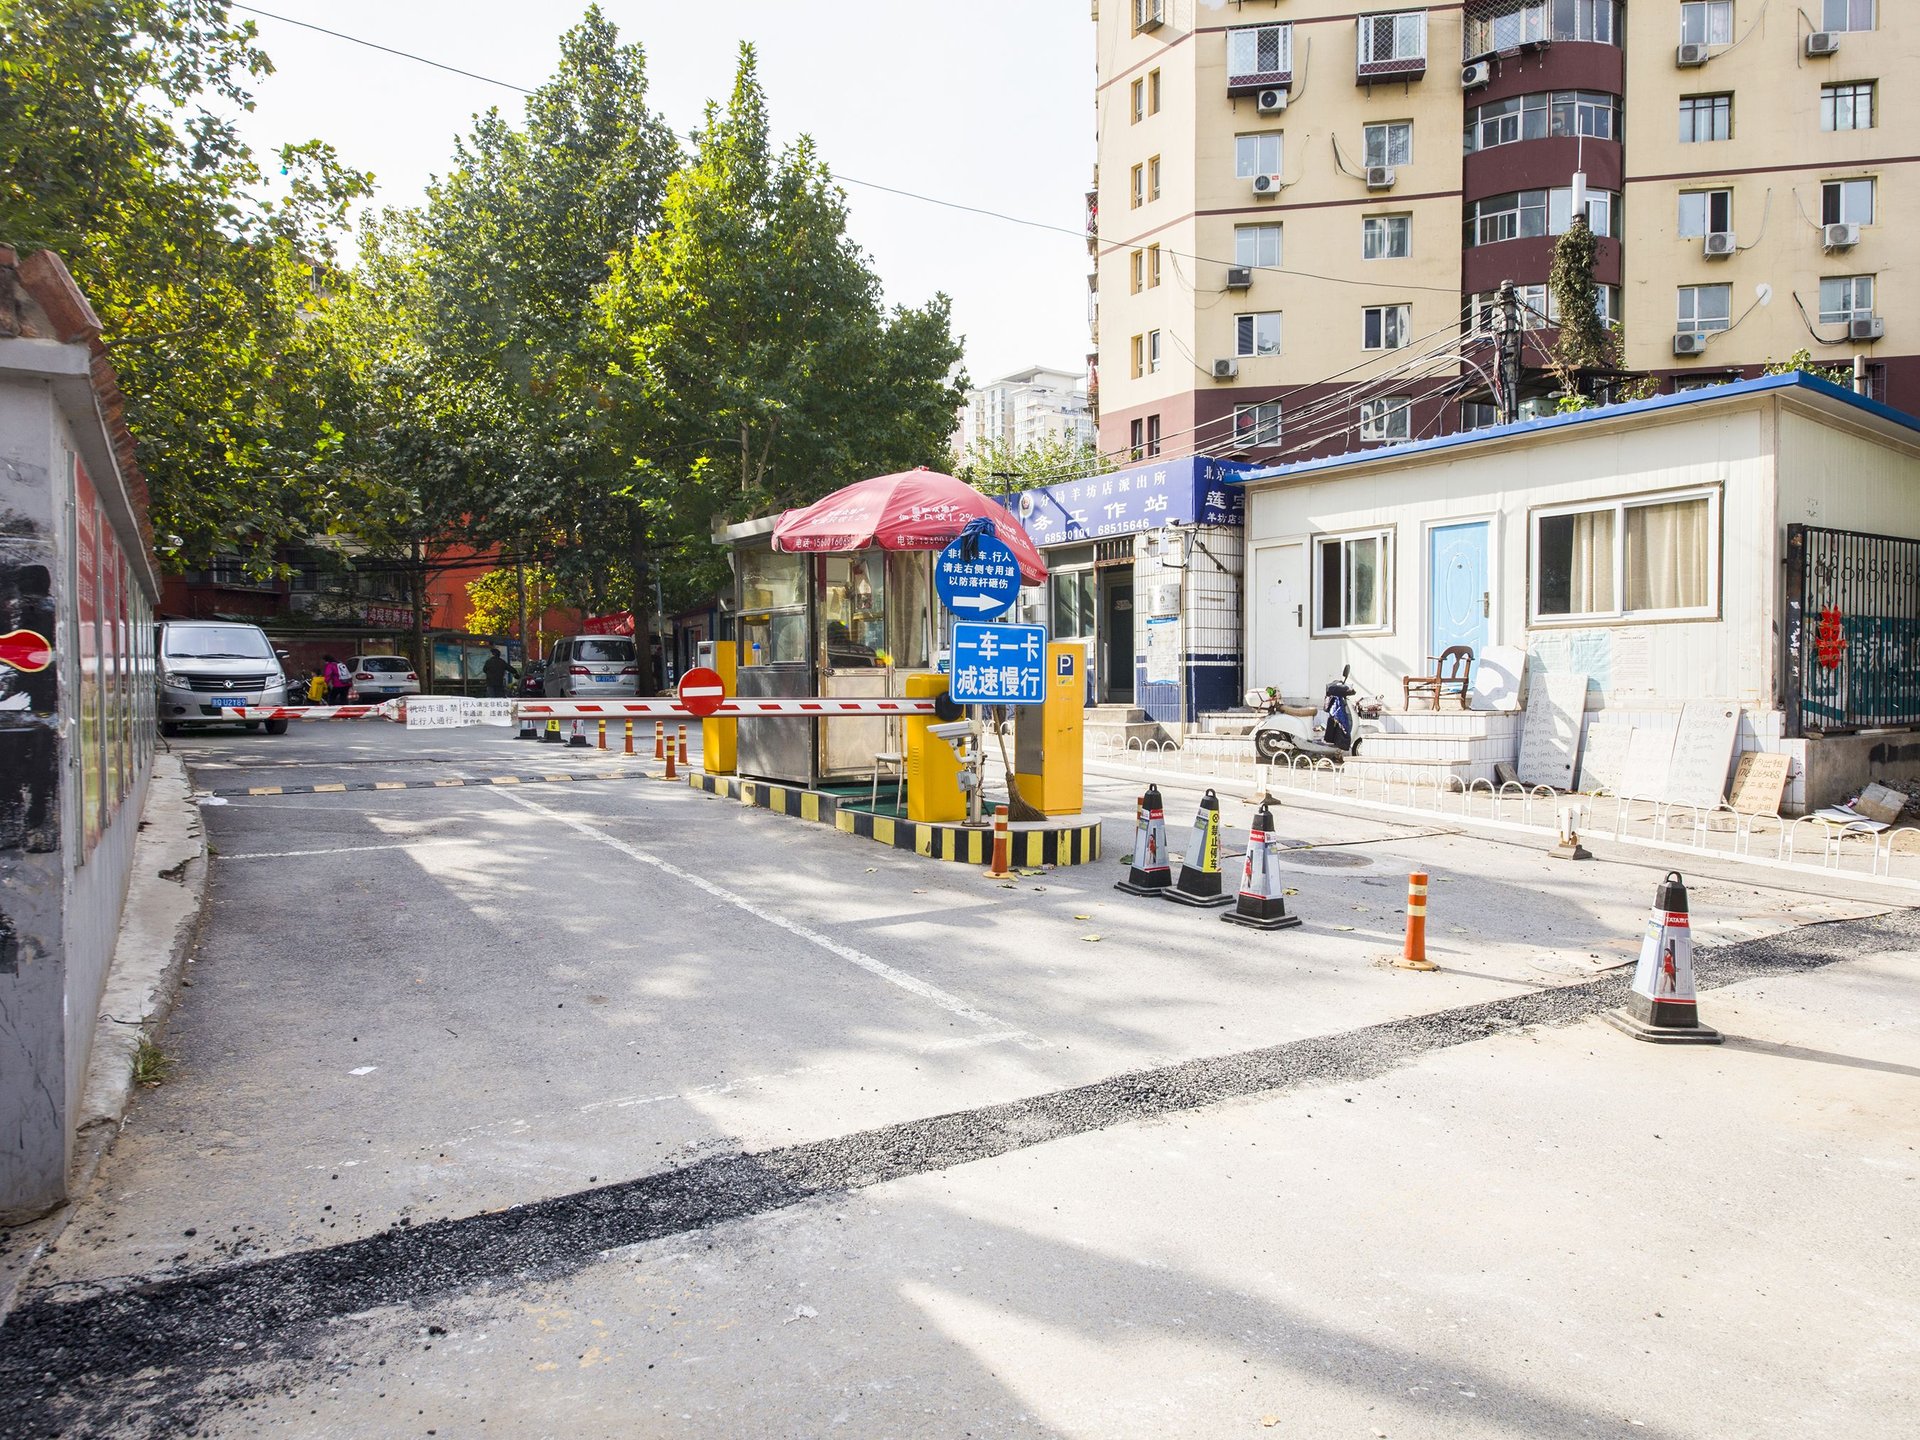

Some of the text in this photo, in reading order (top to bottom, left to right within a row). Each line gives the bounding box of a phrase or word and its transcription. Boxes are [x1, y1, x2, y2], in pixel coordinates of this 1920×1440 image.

[1040, 470, 1168, 507] 分局羊坊店派出所
[1032, 493, 1169, 532] 务工作站
[1044, 527, 1090, 544] 68530101
[1097, 518, 1150, 535] 68515646
[942, 562, 1015, 577] 请走右侧专用道
[947, 548, 1012, 563] 非车、行人
[949, 576, 1009, 589] 以防落杆砸伤
[957, 631, 1040, 662] 一车一卡
[1060, 655, 1072, 674] P
[957, 665, 1041, 697] 减速慢行
[1209, 824, 1219, 870] 禁止停车
